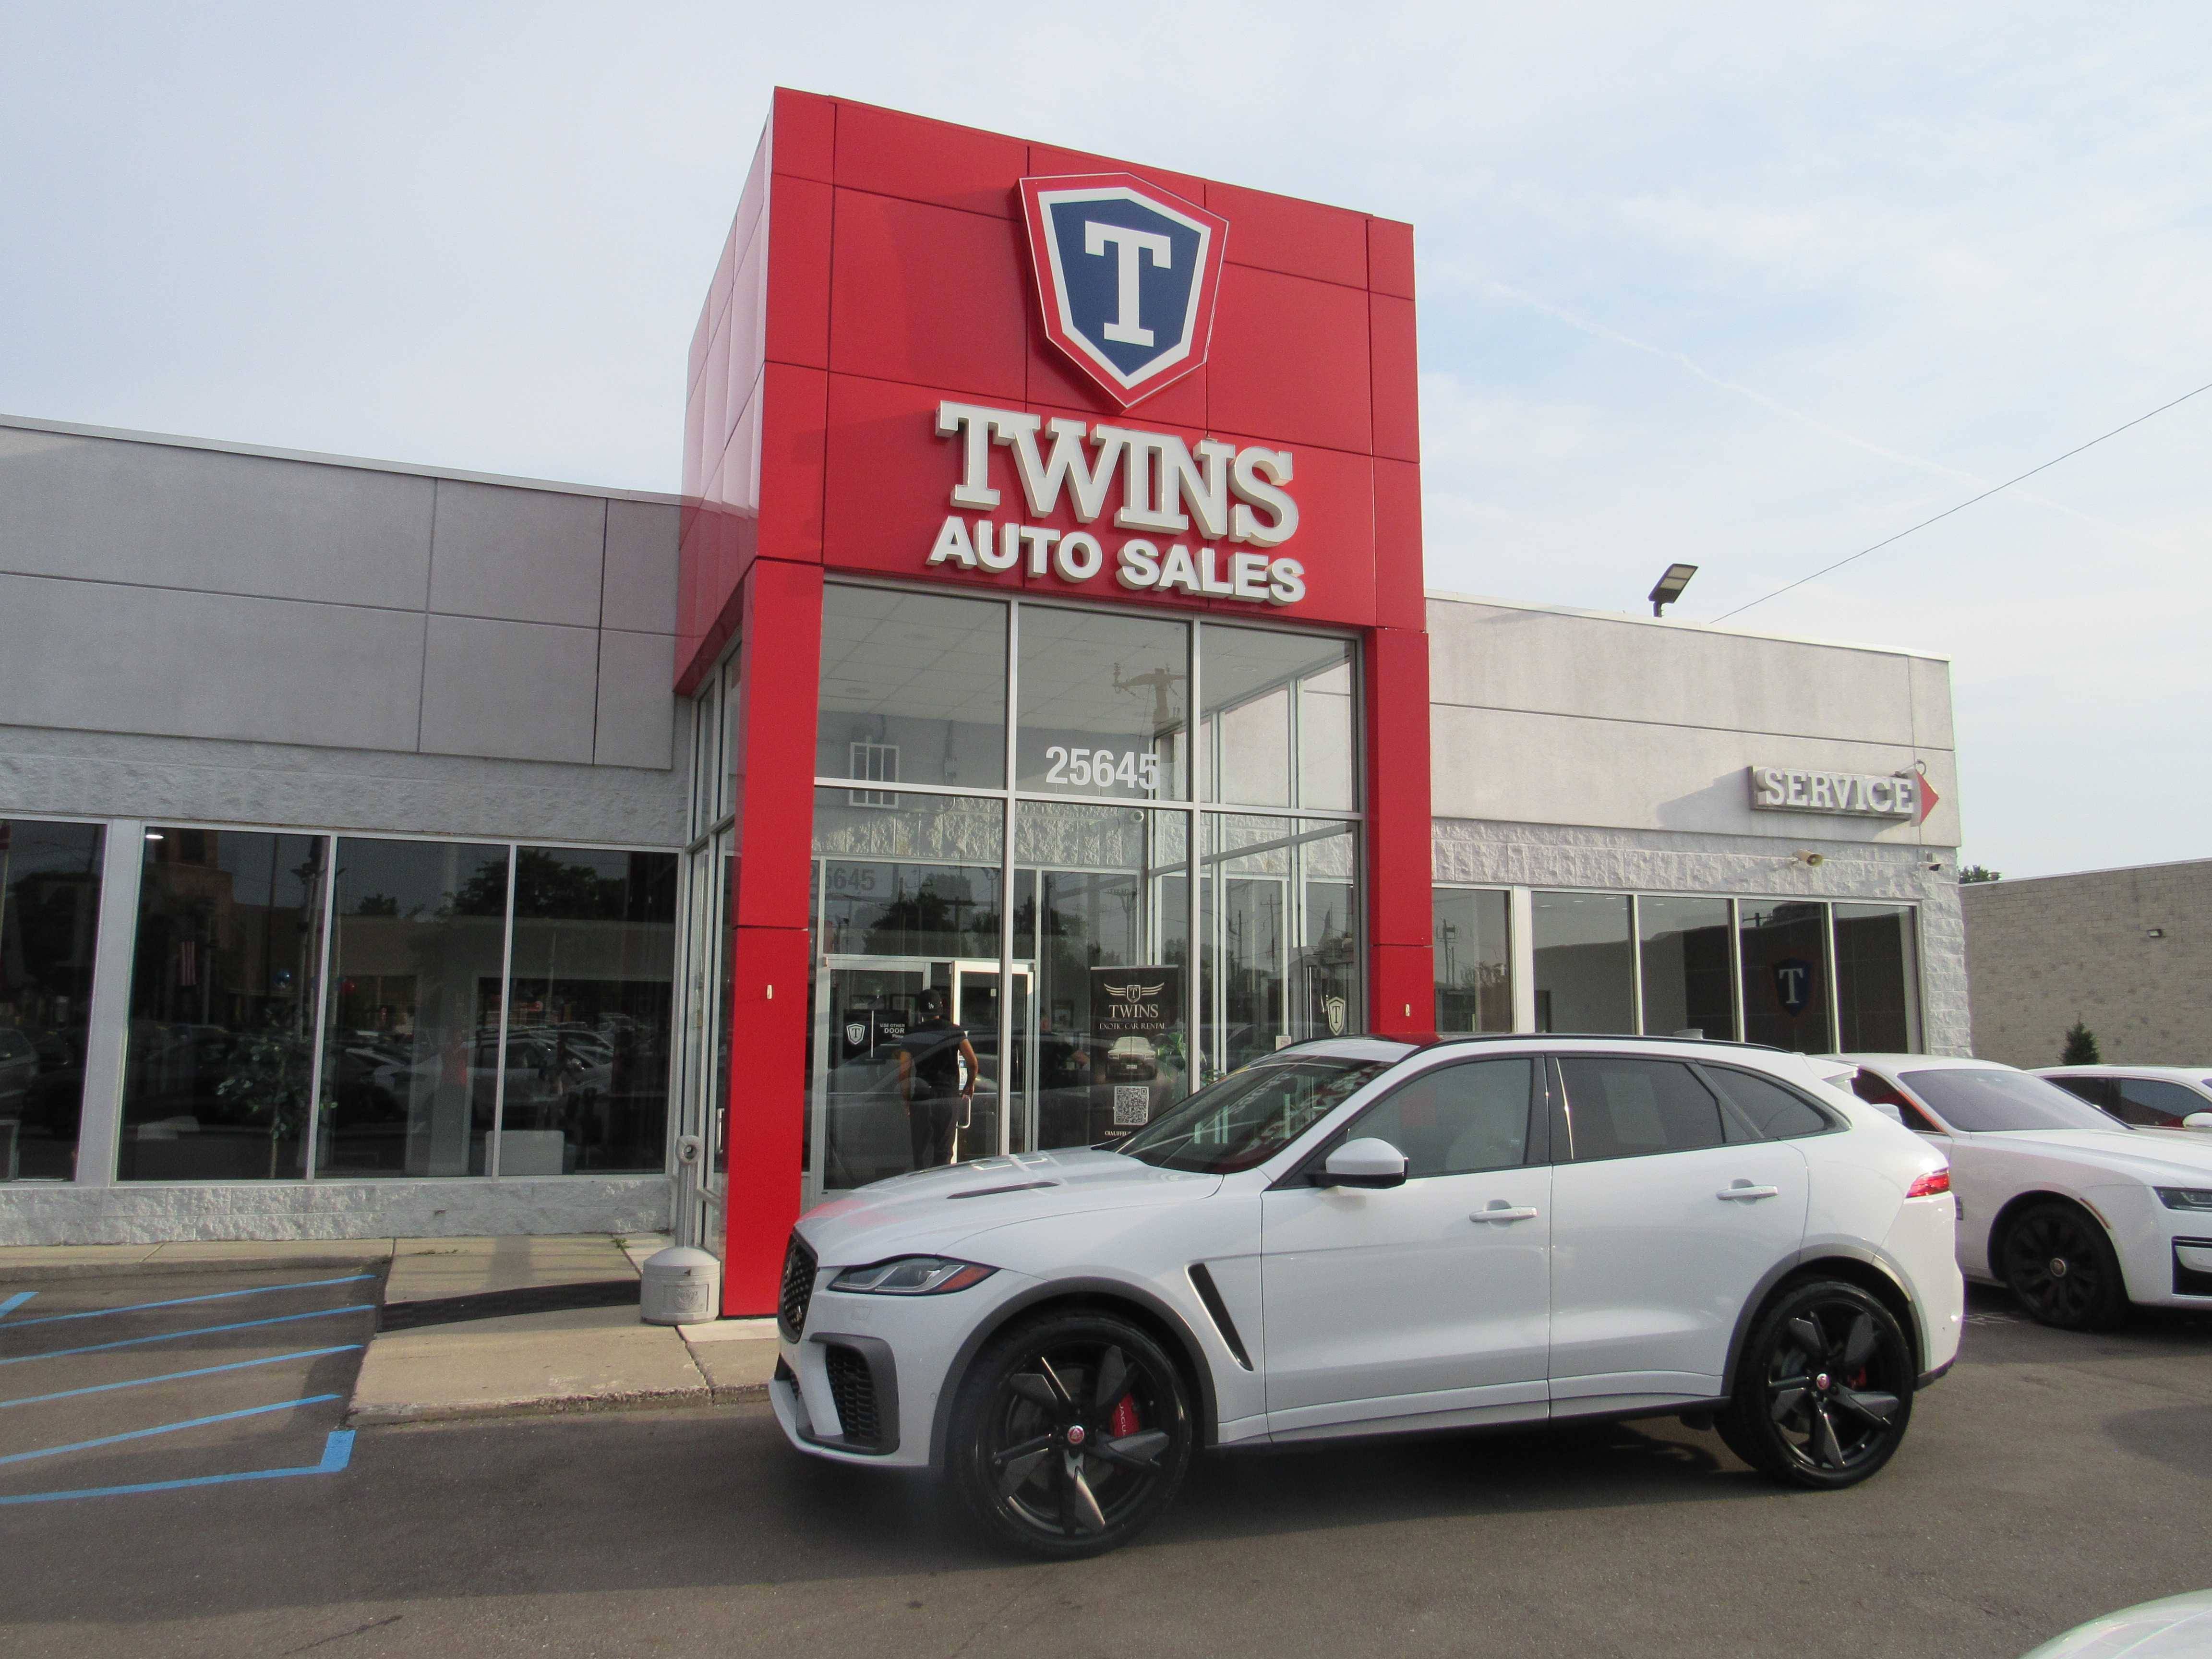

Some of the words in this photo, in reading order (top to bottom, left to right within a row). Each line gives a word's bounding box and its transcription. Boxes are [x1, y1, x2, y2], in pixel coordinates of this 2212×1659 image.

[1084, 220, 1171, 347] T
[935, 400, 1299, 547] TWINS
[926, 516, 1103, 583] AUTO
[1116, 539, 1306, 606] SALES
[1046, 746, 1160, 790] 25645
[1756, 768, 1914, 813] SERVICE
[1130, 987, 1137, 998] T
[1778, 968, 1803, 1003] T
[1109, 1004, 1158, 1018] TWINS
[1332, 1006, 1340, 1023] T
